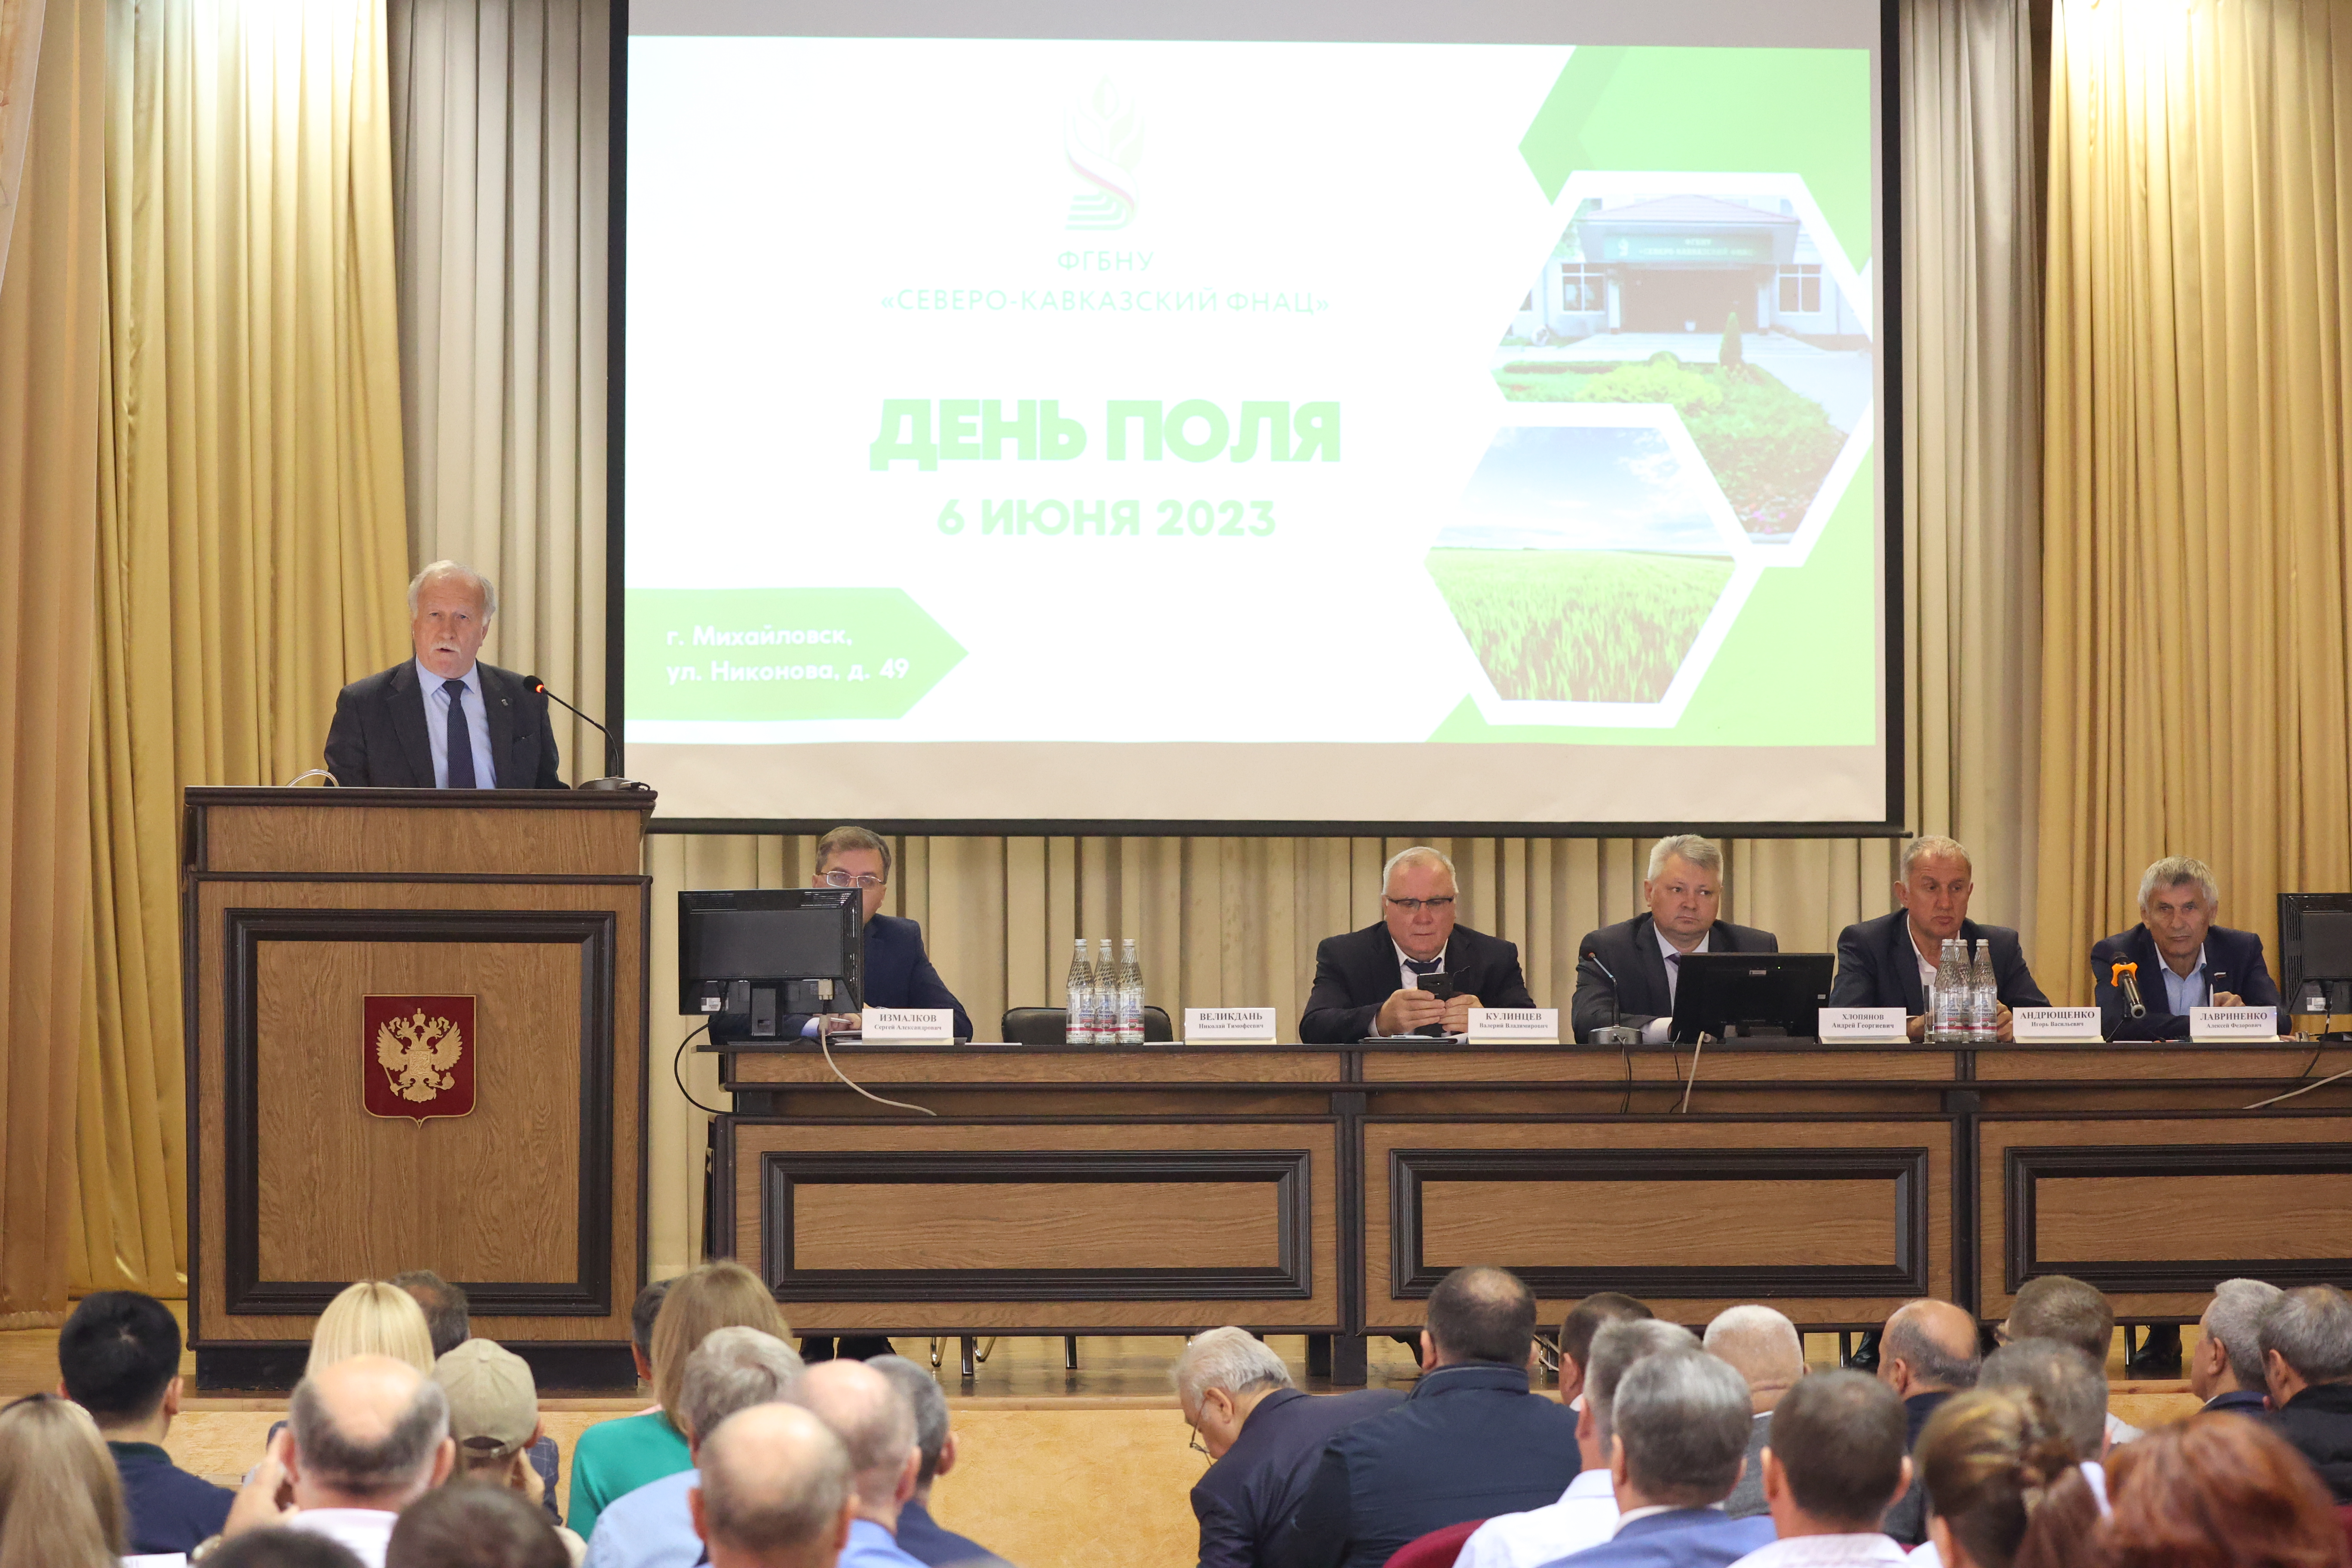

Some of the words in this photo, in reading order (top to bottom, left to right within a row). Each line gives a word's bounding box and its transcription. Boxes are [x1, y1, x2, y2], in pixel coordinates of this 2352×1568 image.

[1057, 251, 1155, 271] ФГБНУ
[881, 287, 1217, 312] «СЕВЕРО-КАВКАЗСКИЙ
[1226, 291, 1329, 315] ФНАЦ»
[870, 399, 1087, 472] ДЕНЬ
[1106, 399, 1341, 463] ПОЛЯ
[937, 499, 965, 536] 6
[981, 499, 1140, 536] ИЮНЯ
[1156, 499, 1276, 537] 2023
[666, 631, 684, 646] г.
[692, 625, 852, 646] Михайловск,
[666, 665, 702, 685] ул.
[710, 659, 840, 682] Никонова,
[847, 664, 870, 682] д.
[879, 658, 910, 679] 49
[879, 1014, 937, 1022] ИЗМАЛКОВ
[1200, 1013, 1262, 1022] ВЕЛИКДАНЬ
[1485, 1013, 1542, 1022] КУЛИНЦЕВ
[2020, 1011, 2095, 1020] АНДРЮЩЕНКО
[2200, 1012, 2267, 1020] ЛАВРИНЕНКО
